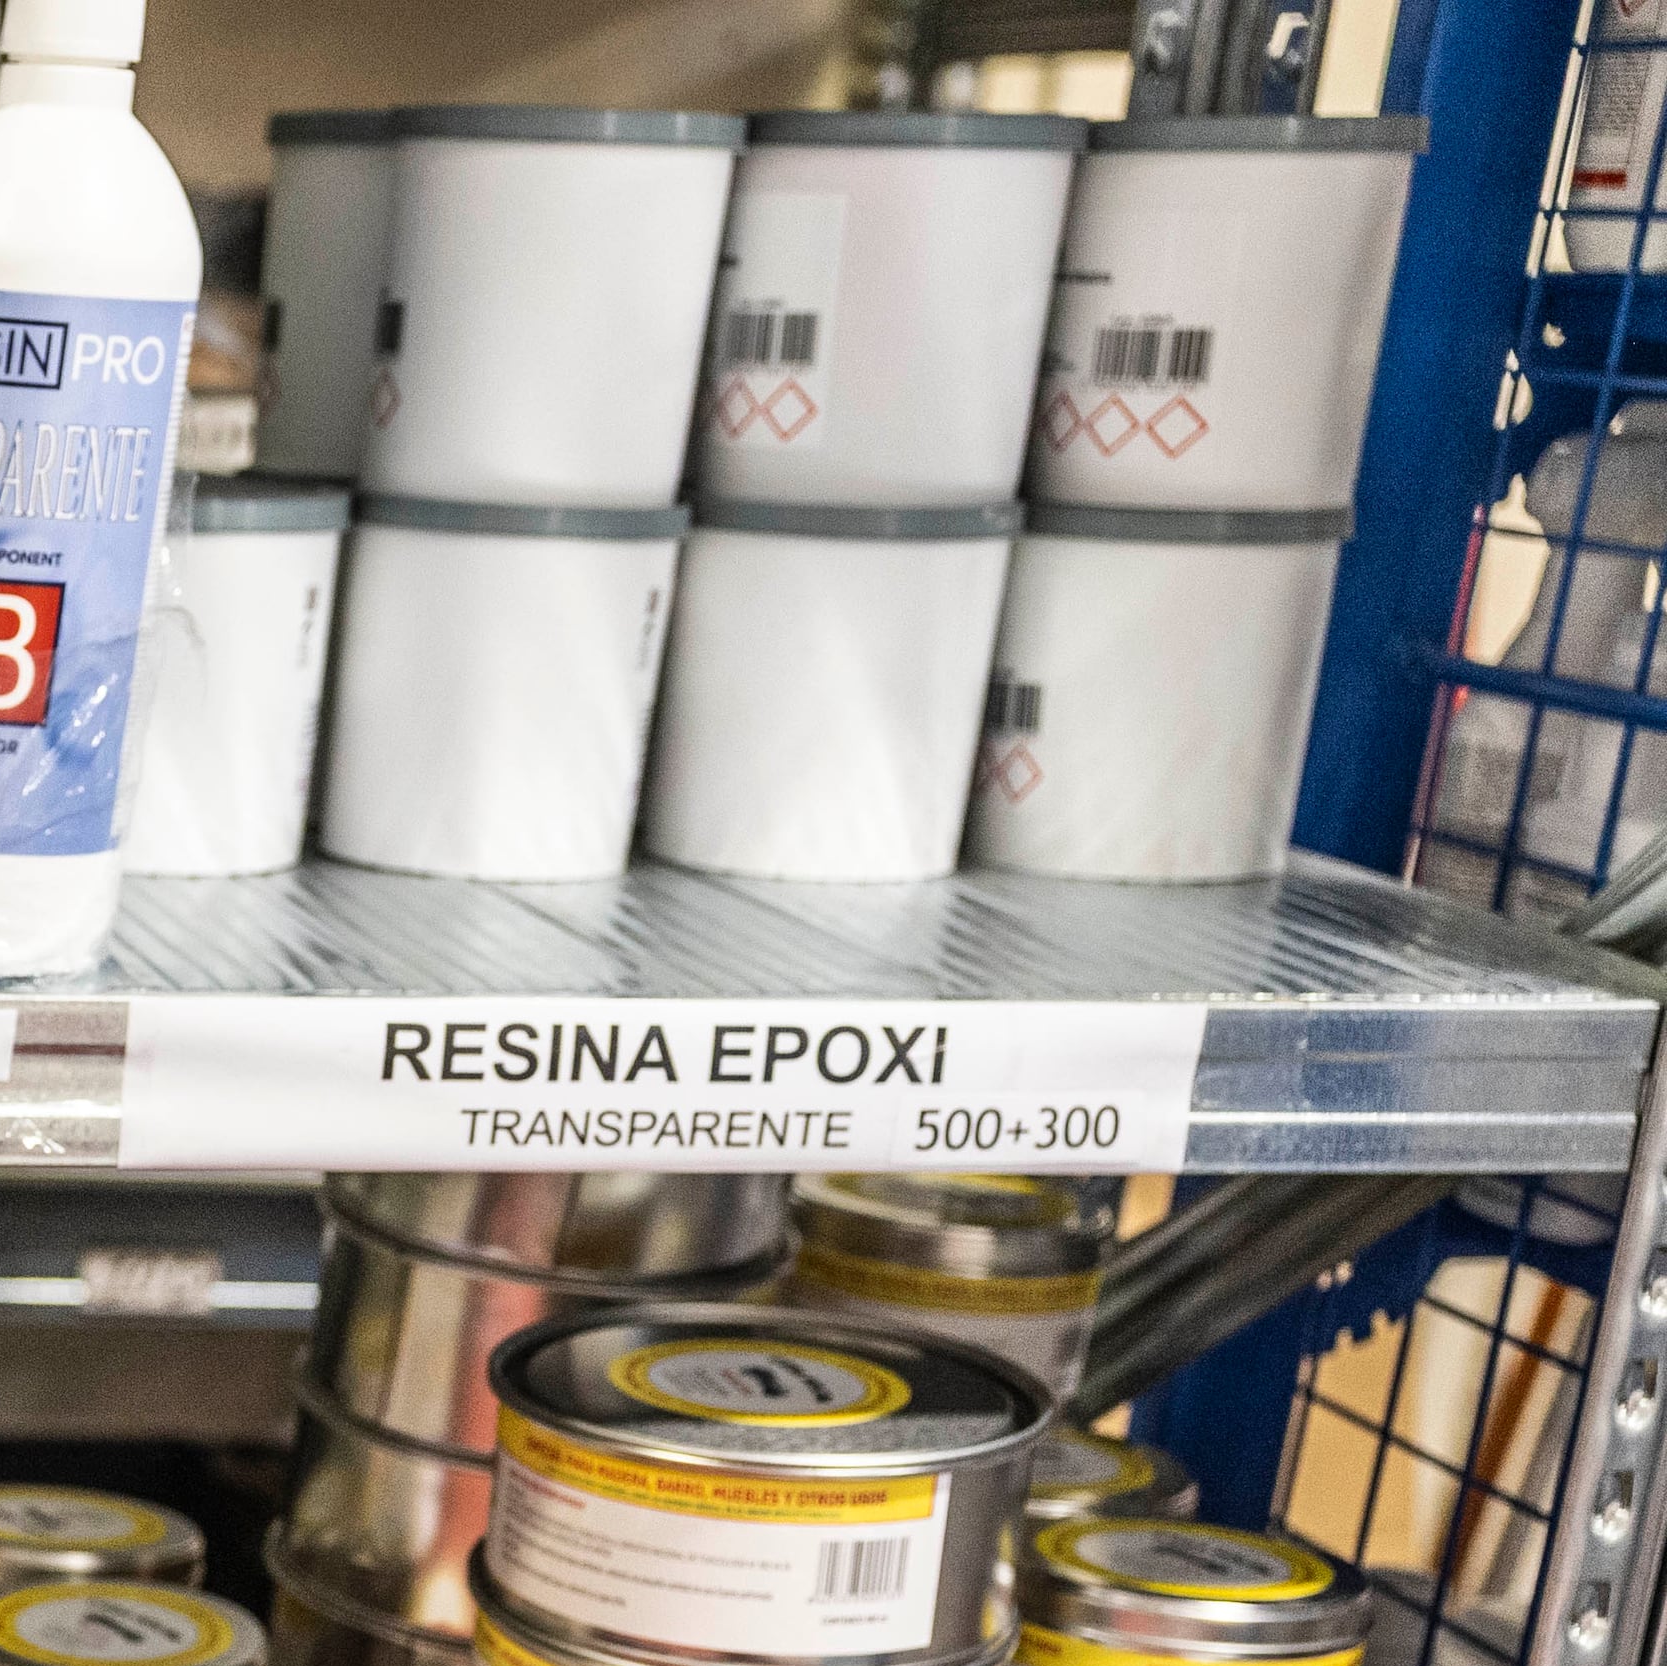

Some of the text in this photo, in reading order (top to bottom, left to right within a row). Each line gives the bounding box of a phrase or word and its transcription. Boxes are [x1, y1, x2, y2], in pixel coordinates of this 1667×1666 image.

[70, 333, 166, 387] PRO
[380, 1021, 948, 1087] RESINA EPOXI
[459, 1108, 853, 1152] TRANSPARENTE
[912, 1104, 1121, 1154] 500+300
